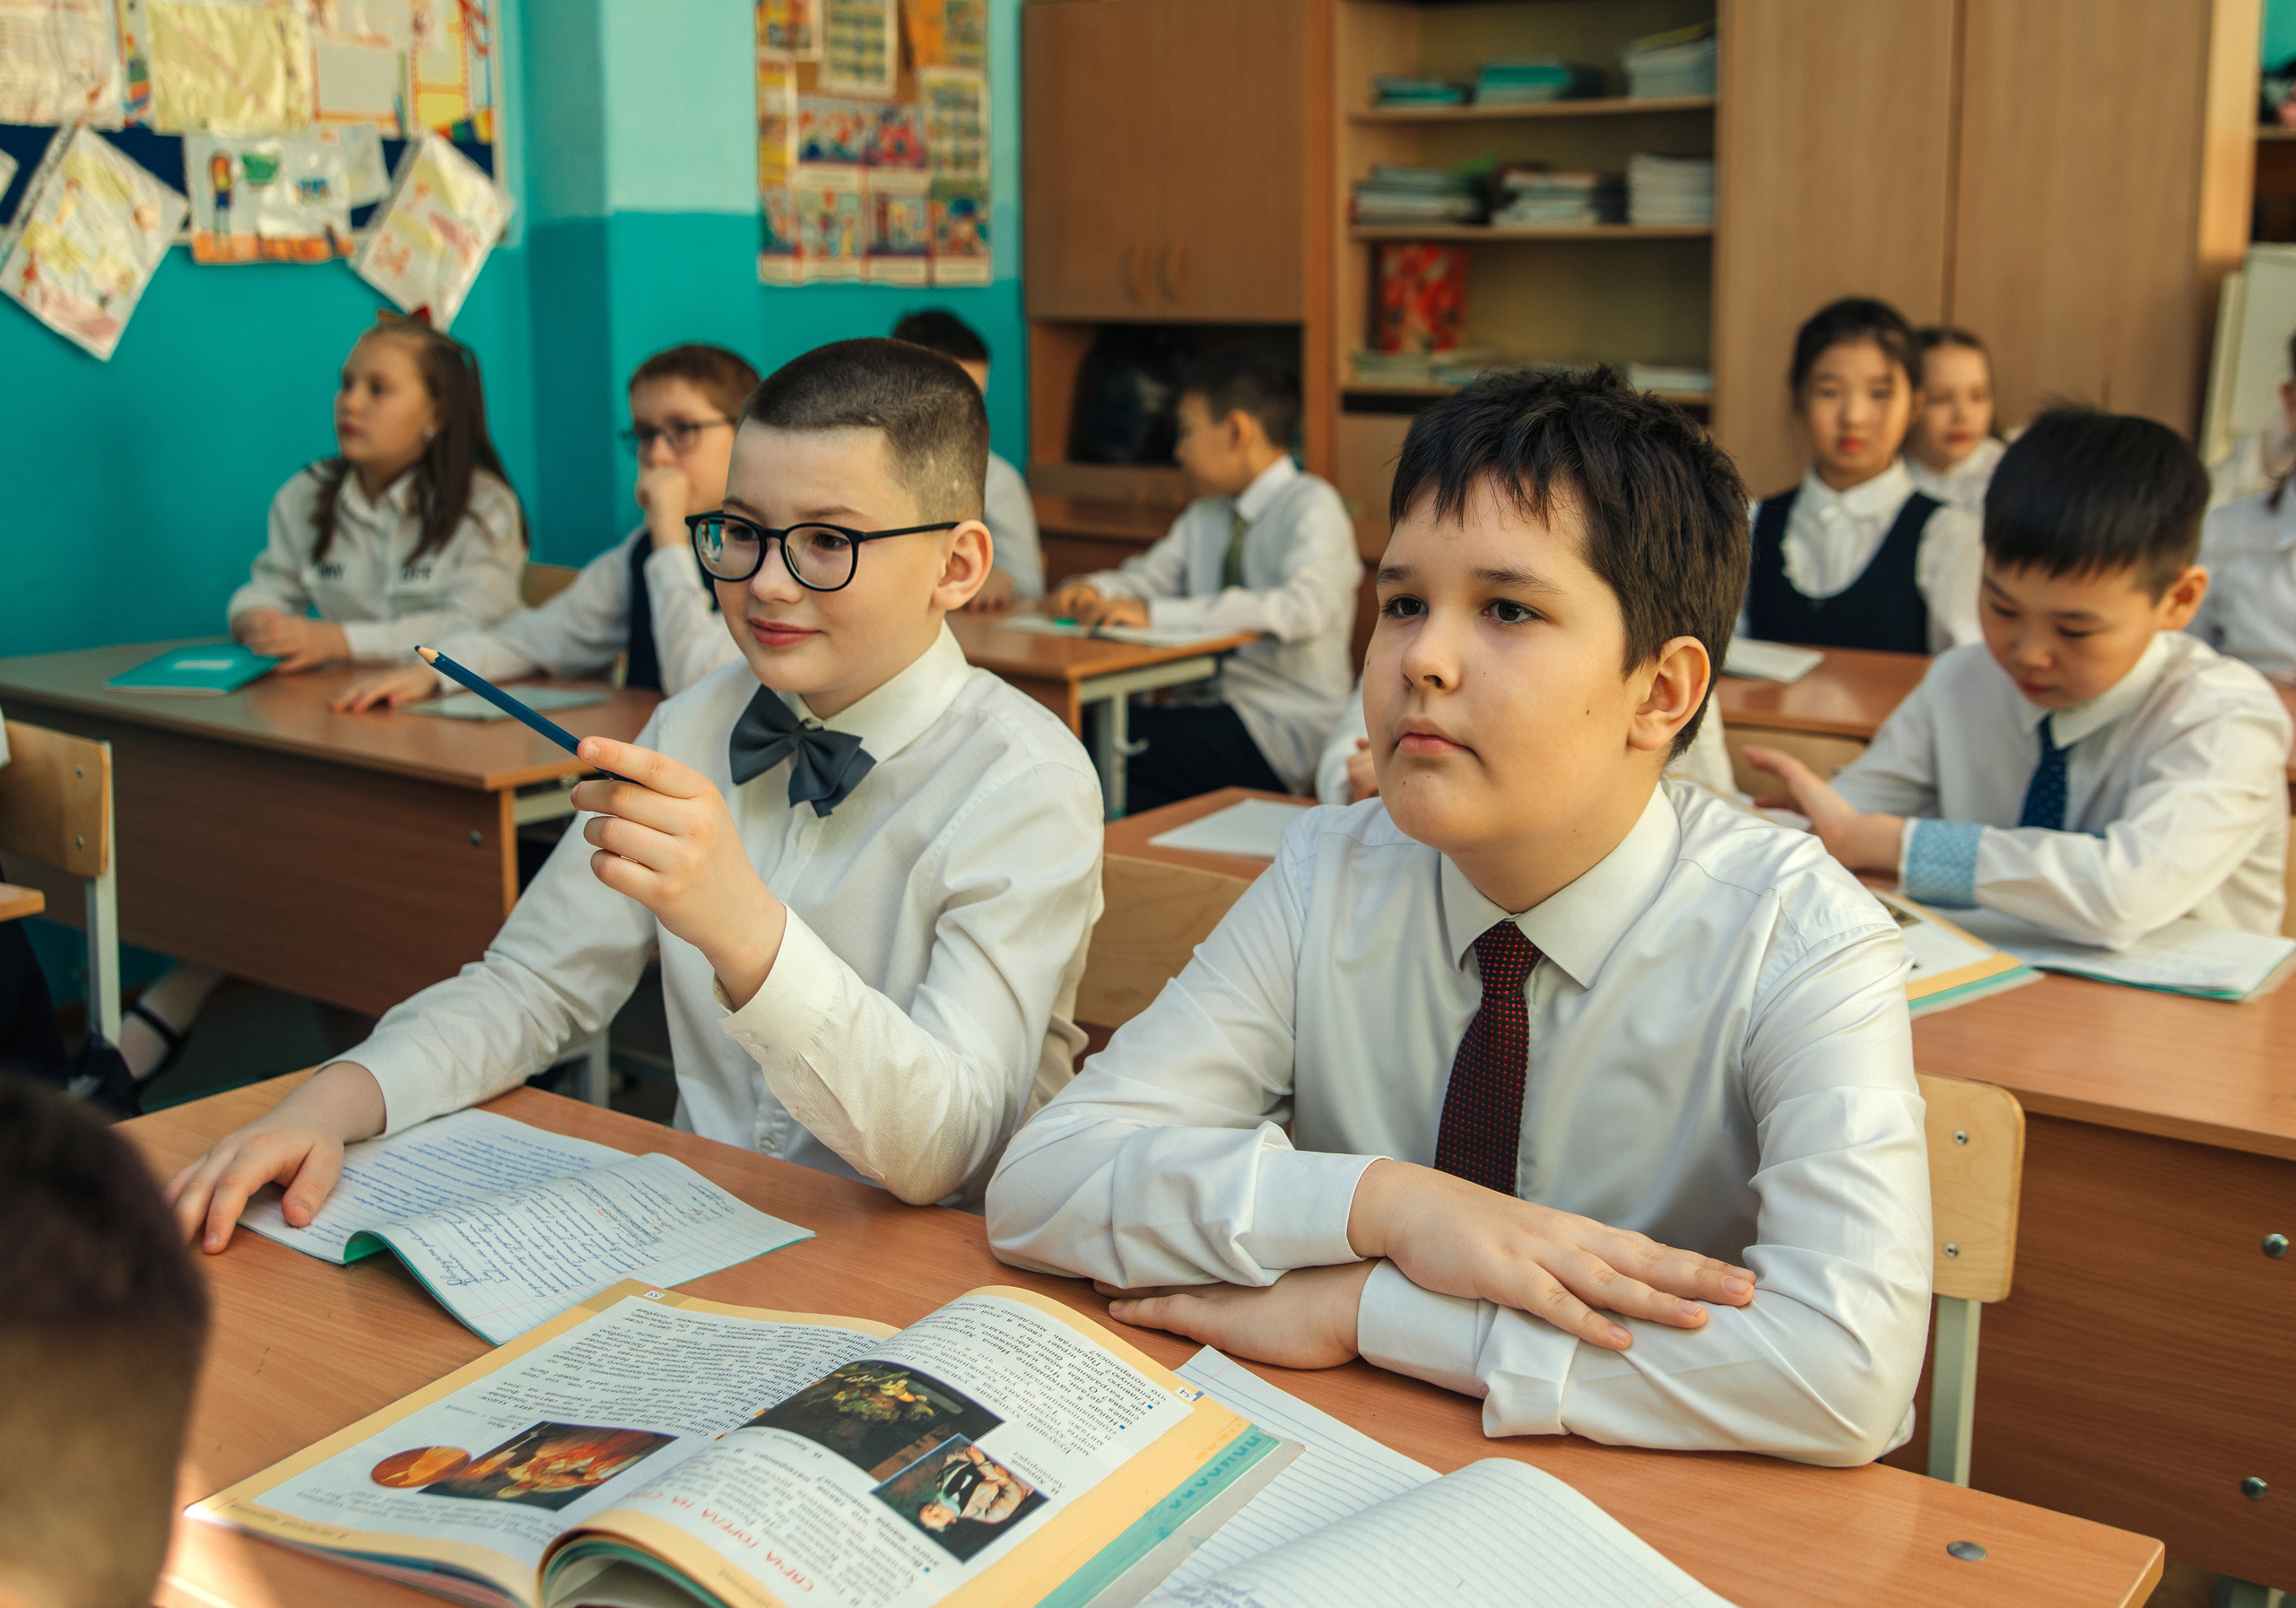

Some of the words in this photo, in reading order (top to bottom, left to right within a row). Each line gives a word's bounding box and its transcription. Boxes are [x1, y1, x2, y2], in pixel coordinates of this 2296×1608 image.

[636, 1308, 670, 1319] голубые
[980, 1309, 1002, 1317] этой
[674, 1317, 718, 1327] возможны
[949, 1316, 974, 1324] такая
[1002, 1310, 1048, 1332] мысленно
[599, 1328, 634, 1340] голубую
[635, 1331, 662, 1339] опыты
[932, 1325, 976, 1338] Хруцкого
[980, 1323, 1031, 1348] рассказать
[1017, 1323, 1042, 1337] свеча
[576, 1341, 612, 1352] горящие
[583, 1336, 622, 1348] установи
[605, 1336, 647, 1348] Посмотри
[639, 1337, 669, 1346] возьми
[665, 1337, 702, 1346] Проведи
[776, 1339, 831, 1349] эксперимент
[807, 1337, 841, 1345] зависит
[982, 1338, 1010, 1355] Ивана
[982, 1331, 1039, 1362] изображено
[1019, 1334, 1063, 1360] бинокль?
[1047, 1339, 1076, 1359] играет
[1053, 1334, 1100, 1367] Представь
[561, 1350, 593, 1360] красно-
[601, 1352, 631, 1362] белого
[616, 1351, 648, 1359] поставь
[836, 1348, 858, 1359] Этот
[552, 1354, 604, 1368] пластиковые
[781, 1359, 805, 1368] Одну
[1033, 1350, 1064, 1369] может
[529, 1367, 550, 1375] быть
[562, 1362, 583, 1370] Тебе
[609, 1366, 658, 1376] прозрачные
[755, 1360, 799, 1372] Напротив
[1082, 1360, 1104, 1376] роль
[1089, 1350, 1146, 1386] потерялось?
[553, 1372, 581, 1381] может
[769, 1368, 797, 1378] белом
[1016, 1356, 1071, 1393] натюрморте
[1067, 1362, 1124, 1401] театральный
[1105, 1369, 1160, 1404] степенную?
[544, 1391, 592, 1402] освещения
[600, 1387, 641, 1395] говорили
[717, 1388, 749, 1396] свечи?
[1108, 1378, 1146, 1405] Главную
[478, 1395, 509, 1405] худож-
[486, 1391, 528, 1404] показыва-
[523, 1393, 559, 1403] светлом
[700, 1396, 735, 1407] третьем
[723, 1395, 758, 1407] бывают
[538, 1409, 579, 1417] картинах
[643, 1404, 708, 1414] единственный
[1101, 1395, 1139, 1420] справа?
[639, 1413, 681, 1423] Сделайте
[671, 1411, 698, 1419] свечи
[1088, 1404, 1118, 1426] Найди
[702, 1417, 731, 1429] пламя
[665, 1422, 709, 1437] Сравните
[672, 1496, 694, 1508] НА
[702, 1508, 759, 1548] ГОРЕЛА
[766, 1552, 813, 1591] СВЕЧА
